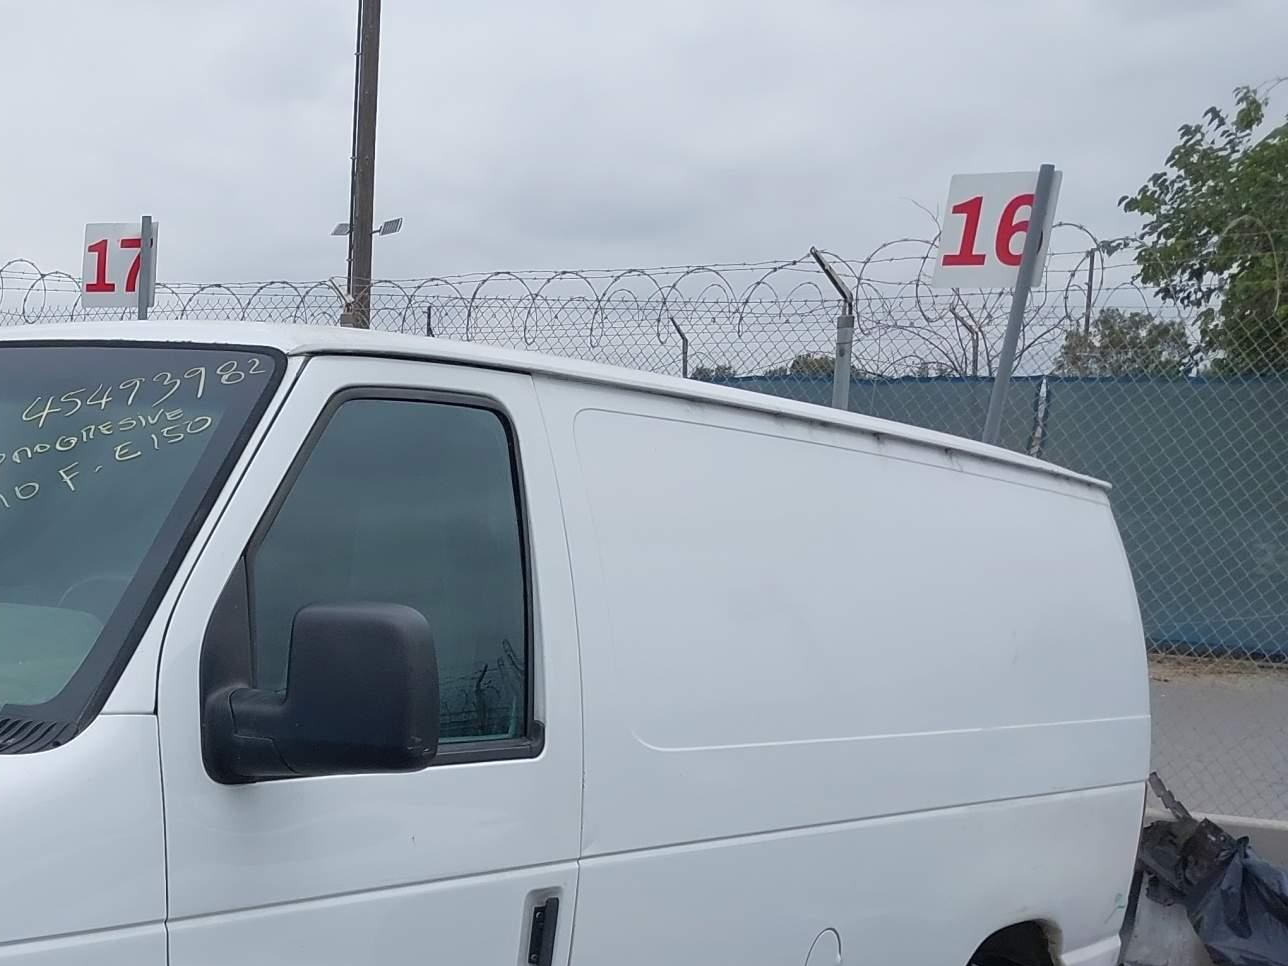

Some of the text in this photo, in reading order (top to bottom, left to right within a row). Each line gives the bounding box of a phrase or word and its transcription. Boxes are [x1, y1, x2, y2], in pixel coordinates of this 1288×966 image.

[942, 193, 1043, 266] 16
[86, 238, 153, 293] 17
[22, 358, 265, 428] 45493982
